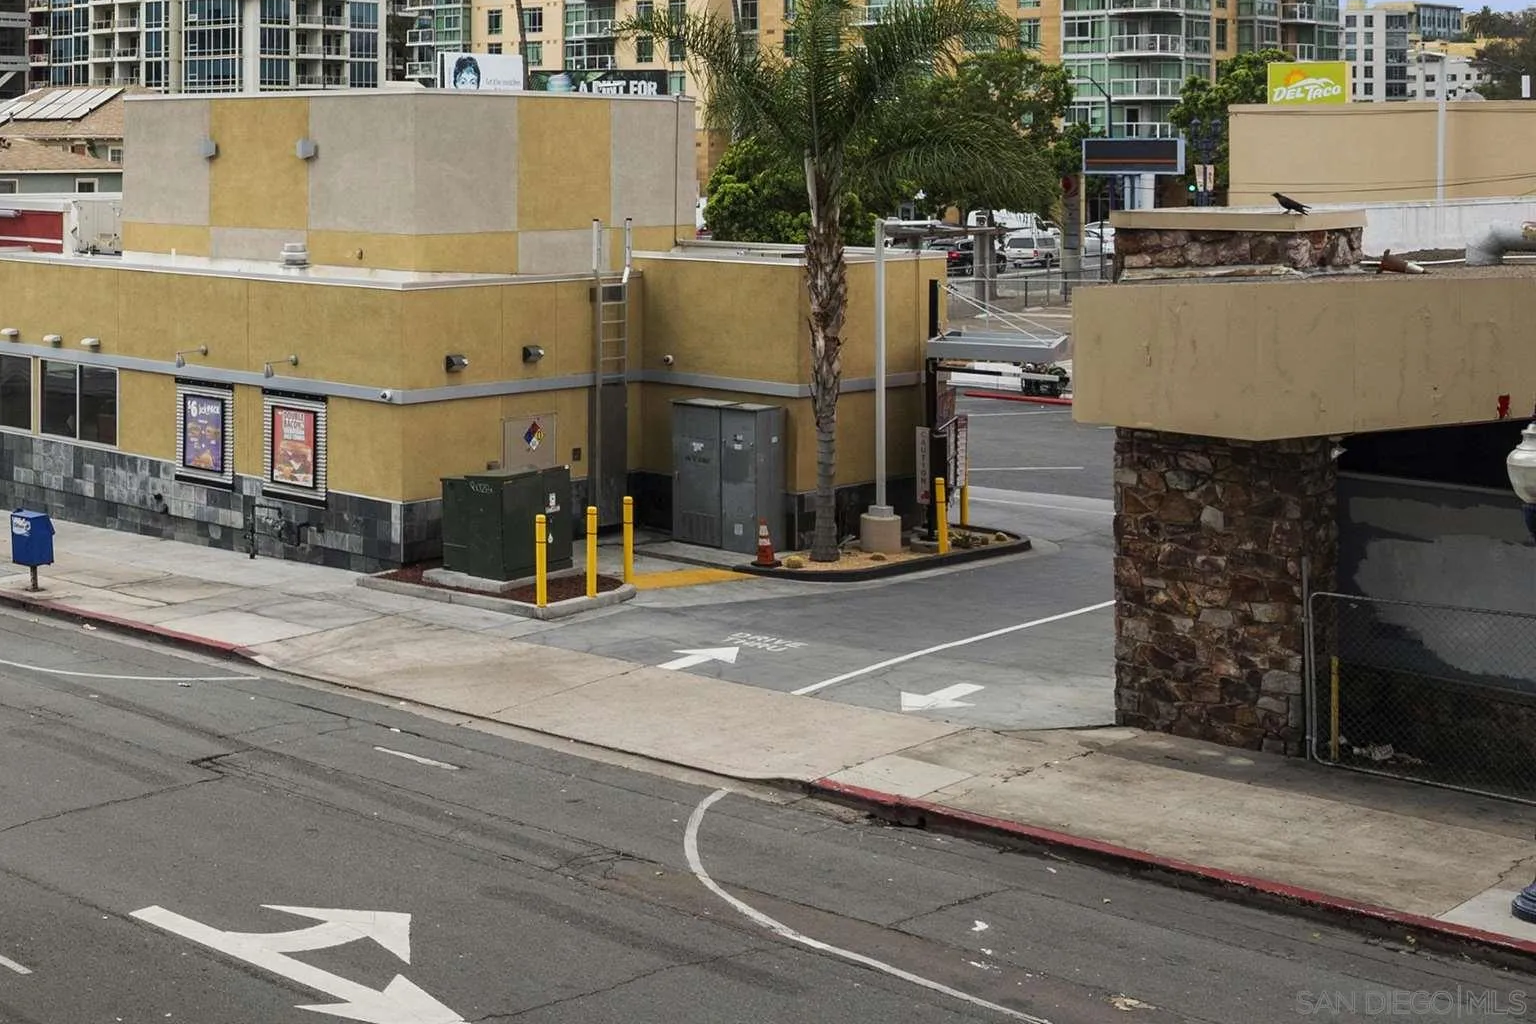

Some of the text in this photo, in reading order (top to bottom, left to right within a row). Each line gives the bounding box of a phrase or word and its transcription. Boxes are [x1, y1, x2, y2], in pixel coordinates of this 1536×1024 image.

[579, 80, 588, 93] A
[629, 80, 658, 95] FOR
[1273, 86, 1304, 102] DEL
